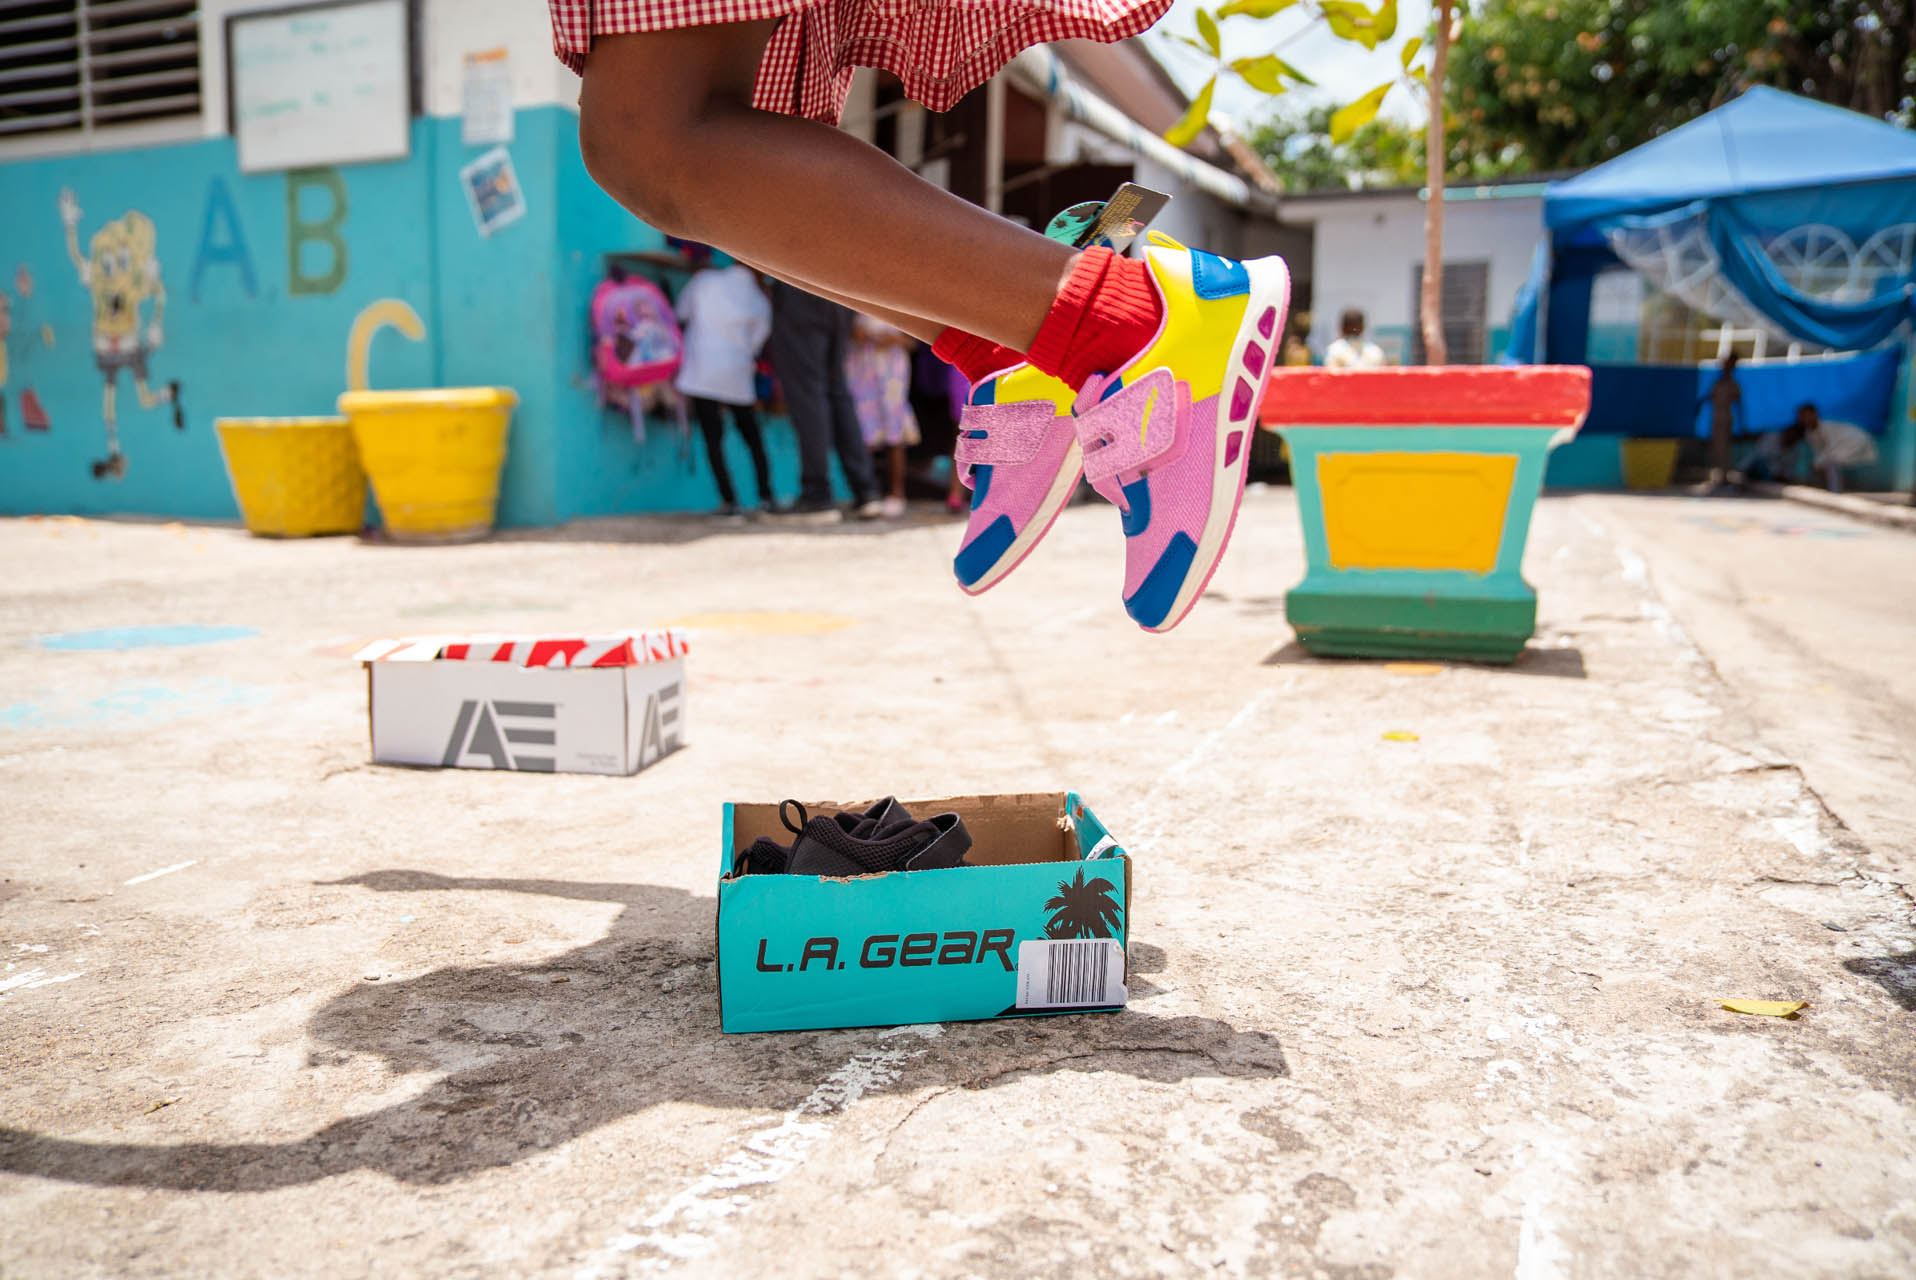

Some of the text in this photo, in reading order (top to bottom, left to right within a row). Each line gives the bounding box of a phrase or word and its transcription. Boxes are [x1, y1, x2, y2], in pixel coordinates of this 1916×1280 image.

[189, 164, 348, 303] A B
[756, 936, 846, 972] L.A.
